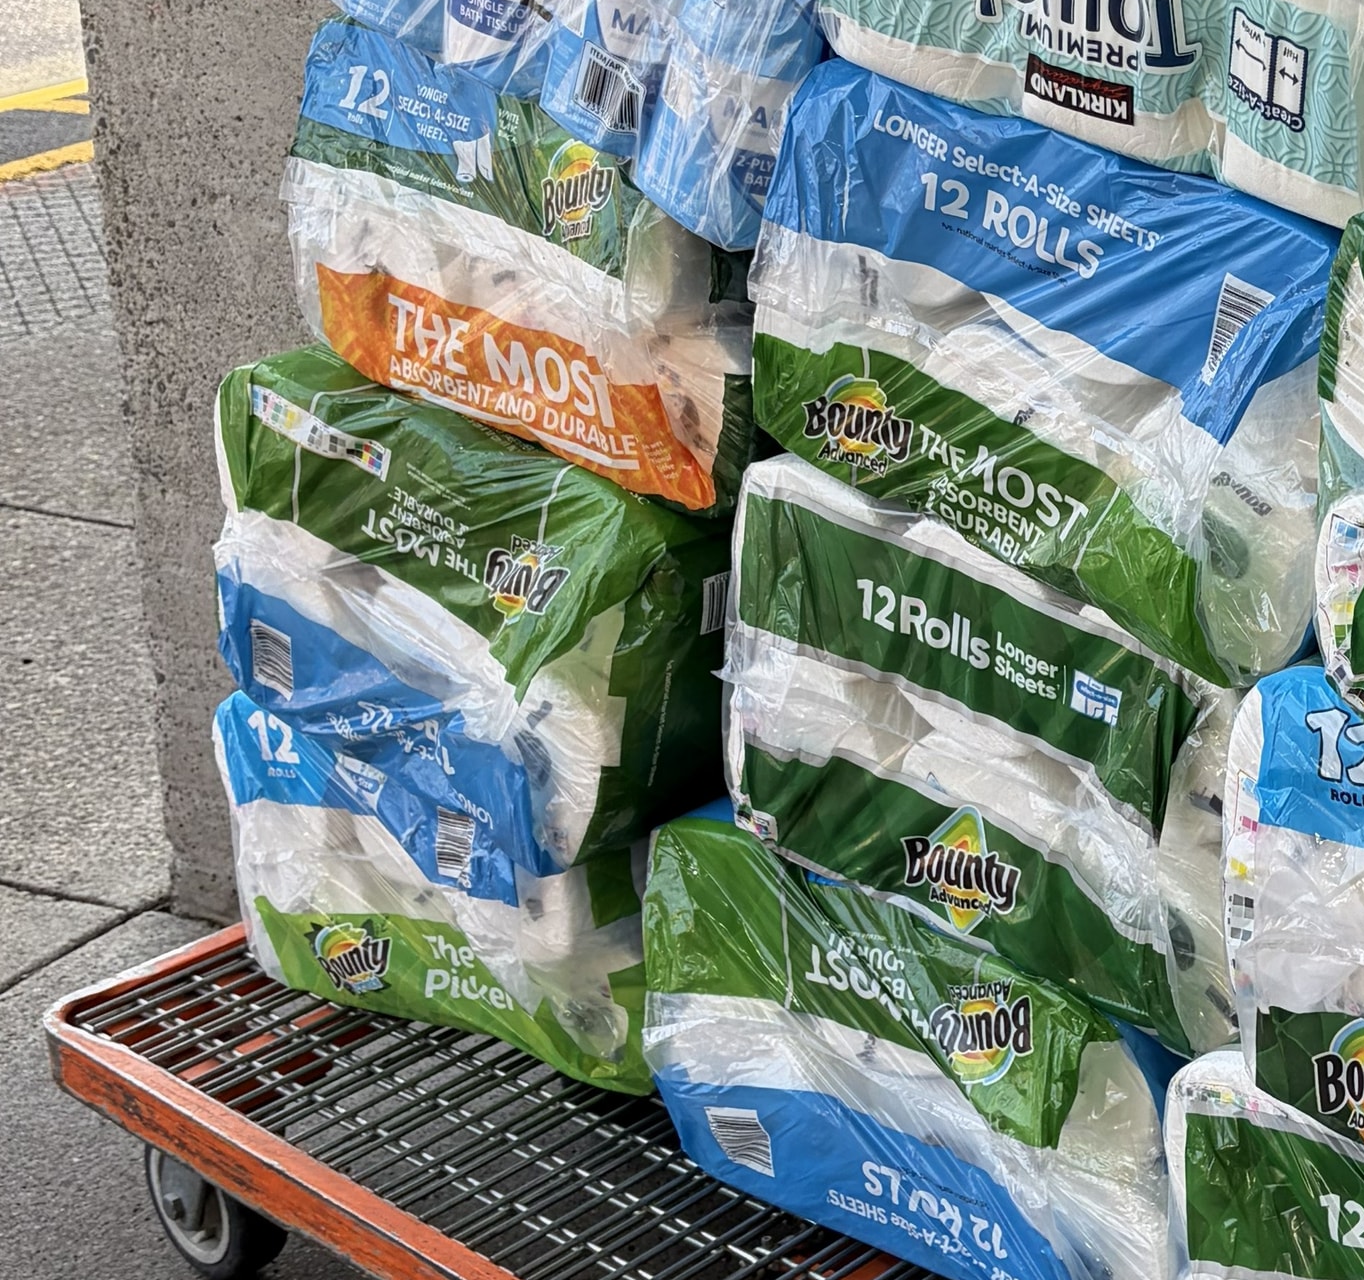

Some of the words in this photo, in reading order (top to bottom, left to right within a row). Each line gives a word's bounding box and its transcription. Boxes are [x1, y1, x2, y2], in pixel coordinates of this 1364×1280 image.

[459, 3, 484, 24] BATH
[1025, 13, 1139, 72] PREMIUM
[339, 65, 391, 120] 12
[416, 83, 449, 105] LONGER
[1031, 72, 1128, 120] KIRKLAND
[735, 155, 774, 171] 2-PLY
[873, 109, 949, 162] LONGER
[951, 145, 1082, 218] Select-A-Size
[541, 161, 615, 236] Bounty
[921, 171, 971, 221] 12
[982, 189, 1105, 280] ROLLS
[956, 226, 985, 246] national
[388, 293, 470, 375] THE
[483, 331, 616, 428] MOST
[390, 354, 494, 408] ABSORBENT
[494, 391, 537, 423] AND
[542, 406, 638, 456] DURABLE
[802, 395, 914, 463] Bounty
[818, 440, 889, 479] Advanced
[918, 423, 967, 475] THE
[955, 443, 1090, 544] MOST
[361, 508, 442, 568] MOST
[444, 548, 481, 584] THE
[857, 578, 897, 633] 12
[899, 594, 991, 670] Rolls
[996, 631, 1060, 680] Longer
[247, 710, 300, 766] 12
[267, 765, 297, 779] ROLLS
[901, 834, 1021, 914] Bounty
[929, 886, 992, 915] Advanced
[318, 937, 392, 991] Bounty
[422, 934, 476, 968] The
[930, 995, 1034, 1061] Bounty
[969, 1213, 1008, 1259] 12
